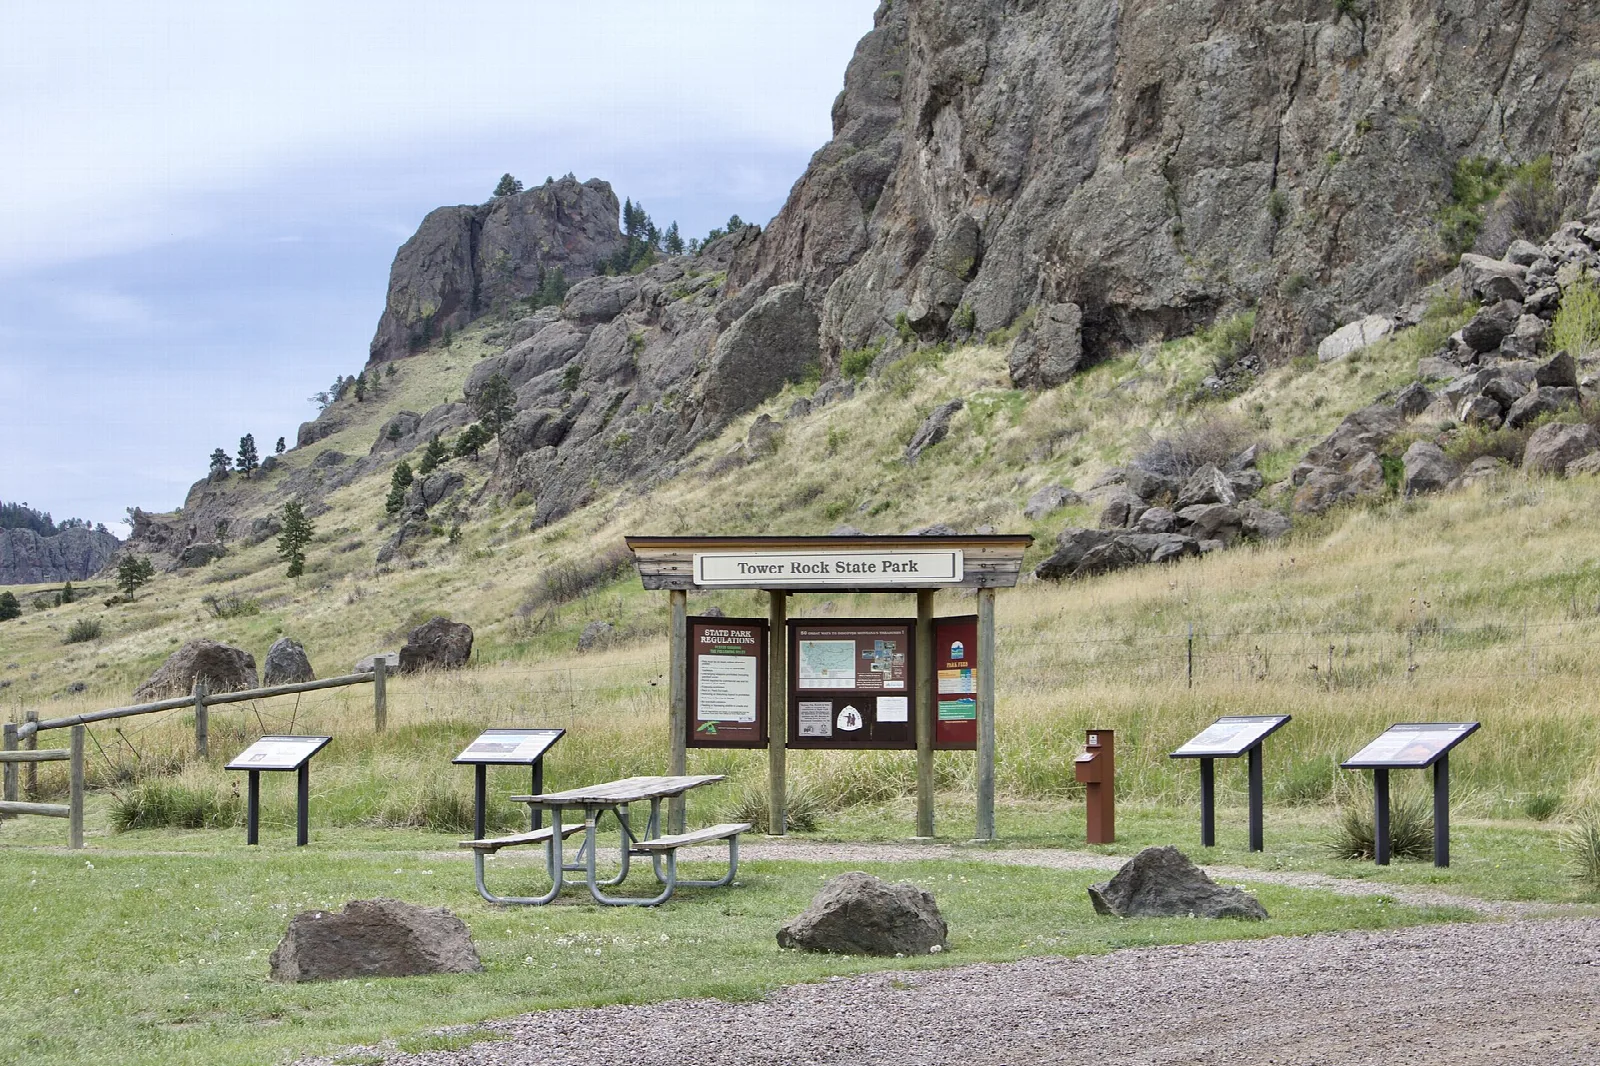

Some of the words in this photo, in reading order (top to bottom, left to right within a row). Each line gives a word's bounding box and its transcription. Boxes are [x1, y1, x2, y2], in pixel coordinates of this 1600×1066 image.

[737, 562, 785, 574] Tower
[790, 561, 830, 574] Rock
[835, 561, 877, 573] State
[881, 560, 919, 573] Park
[704, 629, 729, 637] STATE
[730, 630, 752, 638] PARK
[700, 636, 755, 644] REGULATIONS
